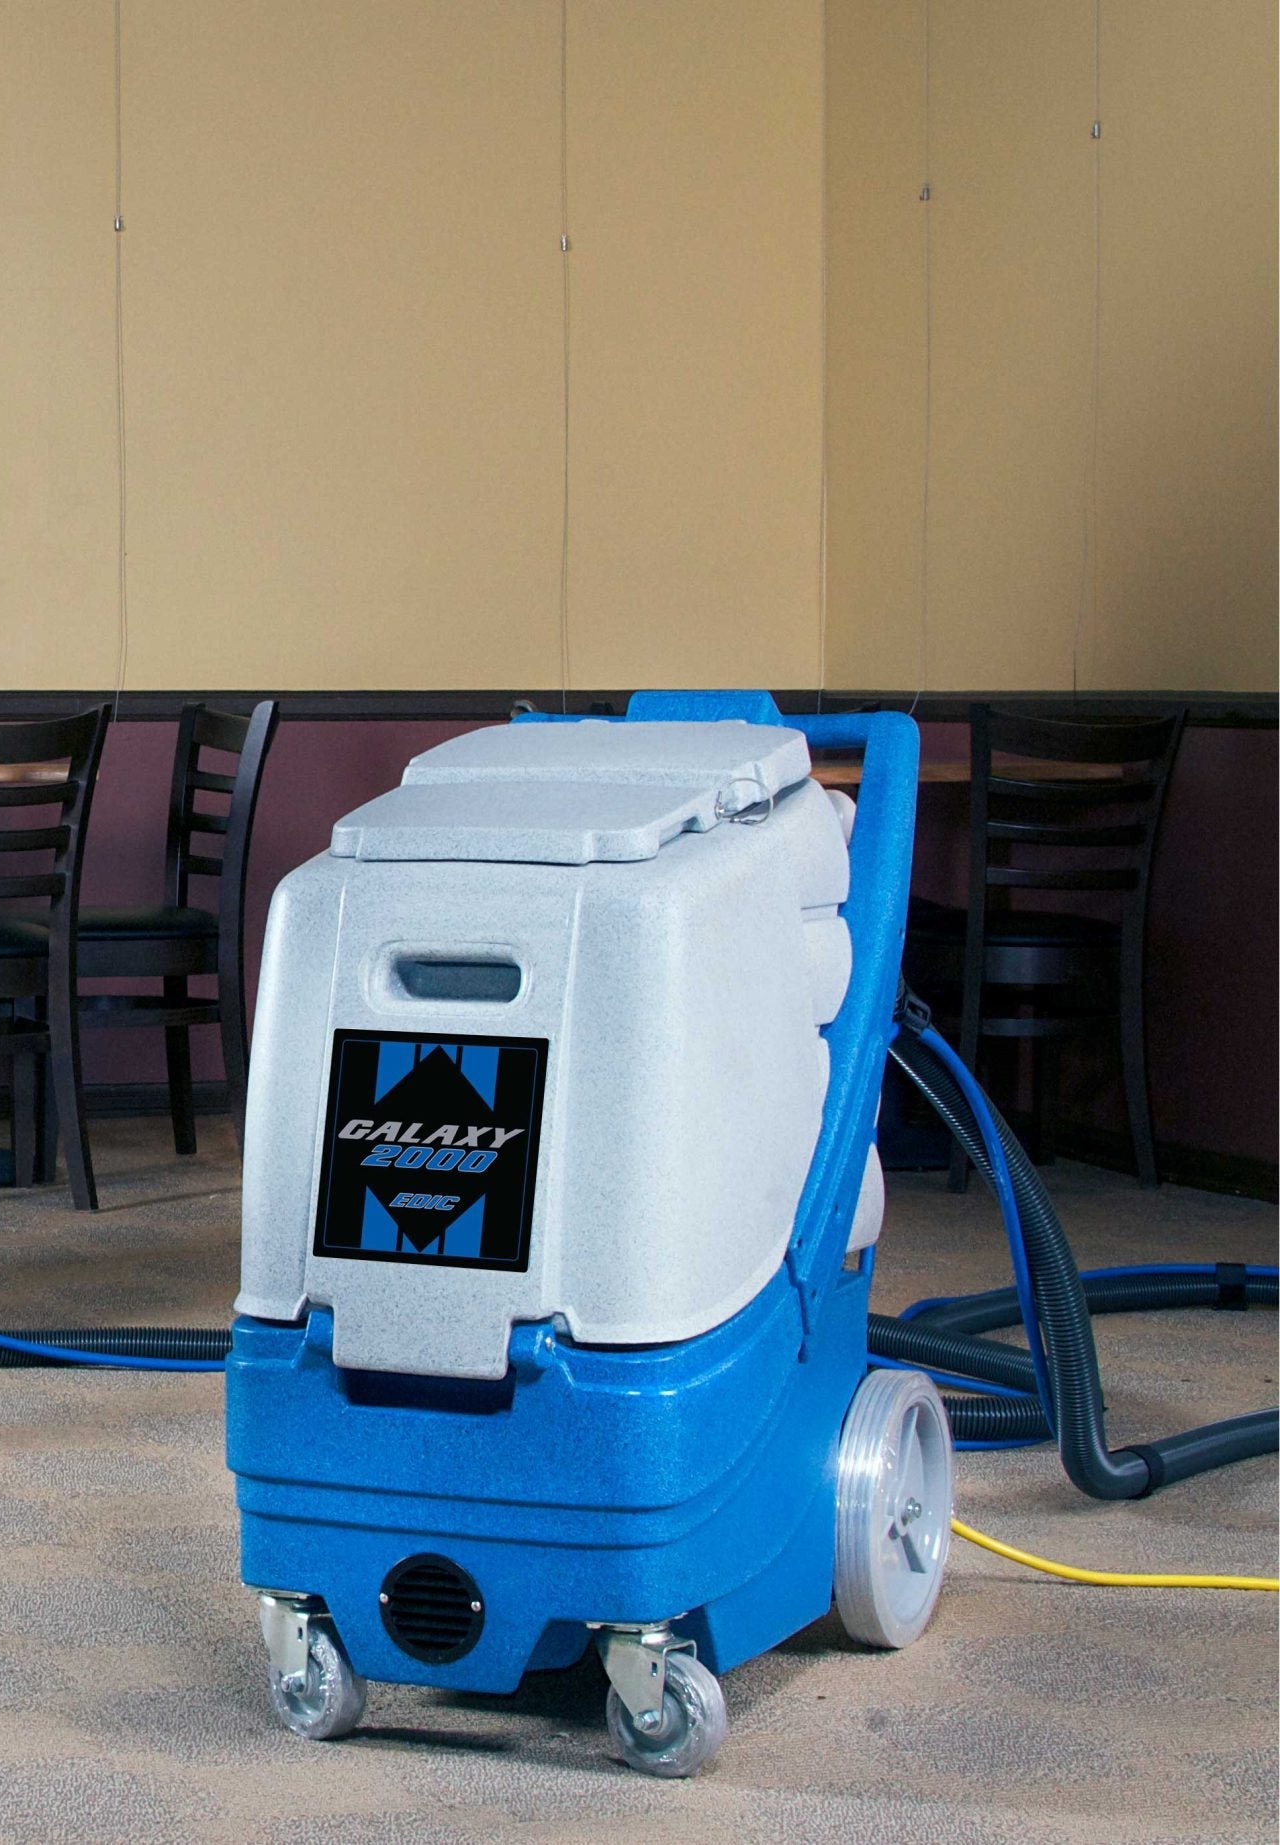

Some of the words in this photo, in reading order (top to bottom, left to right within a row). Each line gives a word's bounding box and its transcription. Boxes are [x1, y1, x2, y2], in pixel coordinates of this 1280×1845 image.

[338, 1119, 525, 1148] GALAXY
[360, 1144, 498, 1173] 2000
[389, 1192, 460, 1210] EDIC
